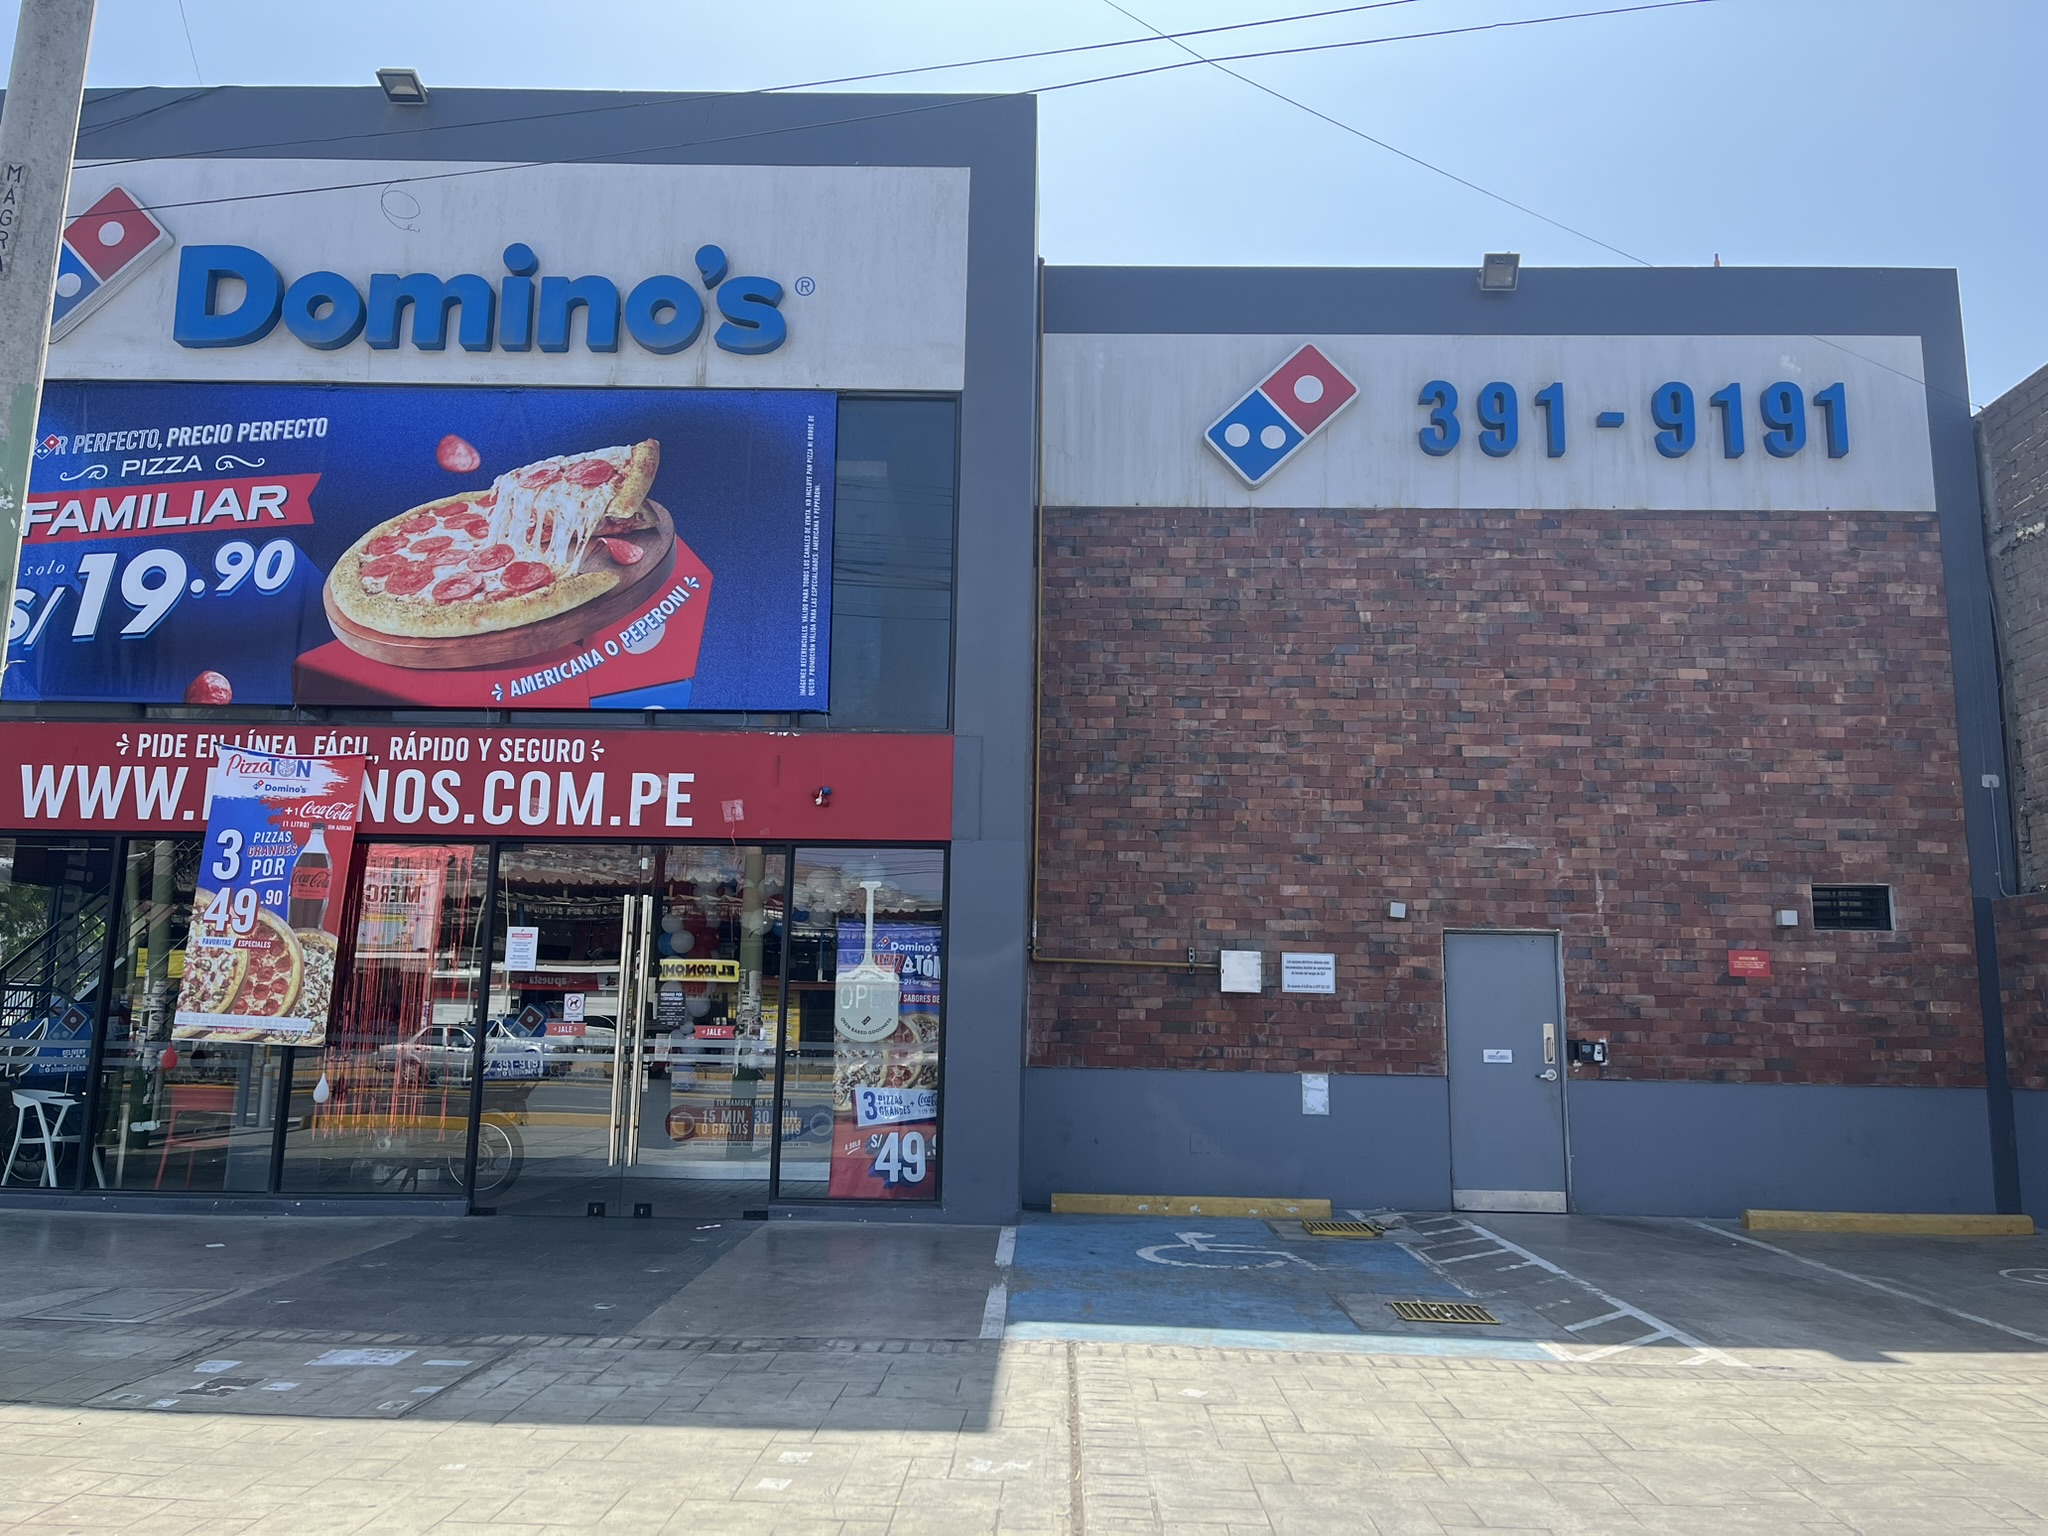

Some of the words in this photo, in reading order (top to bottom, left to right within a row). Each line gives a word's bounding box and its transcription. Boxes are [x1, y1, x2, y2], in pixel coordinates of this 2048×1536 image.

[173, 242, 787, 355] Domino's
[72, 428, 163, 454] PERFECTO,
[166, 422, 233, 448] PRECIO
[237, 416, 328, 442] PERFECTO
[120, 454, 203, 478] PIZZA
[22, 484, 289, 537] FAMILIAR
[24, 562, 66, 576] solo
[509, 647, 605, 698] AMERICANA
[604, 639, 620, 657] O
[618, 584, 692, 649] PEPERONI
[137, 734, 188, 758] PIDE
[195, 734, 225, 758] EN
[313, 730, 380, 764] FÁCIL,
[389, 731, 469, 762] RÁPIDO
[478, 737, 491, 762] Y
[499, 738, 586, 763] SEGURO
[264, 784, 307, 794] Domino's
[300, 800, 356, 820] Coca-Cola
[253, 831, 292, 844] PIZZAS
[212, 828, 243, 880] 3
[247, 844, 298, 857] GRANDES
[250, 858, 286, 877] POR
[238, 940, 272, 948] ESPECIALES
[890, 942, 938, 952] Domino's
[904, 994, 931, 1003] SABORES
[557, 1025, 573, 1034] JALE
[863, 1090, 878, 1120] 3
[878, 1094, 903, 1105] PIZZAS
[702, 1110, 716, 1122] 15
[721, 1110, 749, 1123] MIN.
[754, 1110, 770, 1123] 30
[712, 1124, 748, 1135] GRATIS
